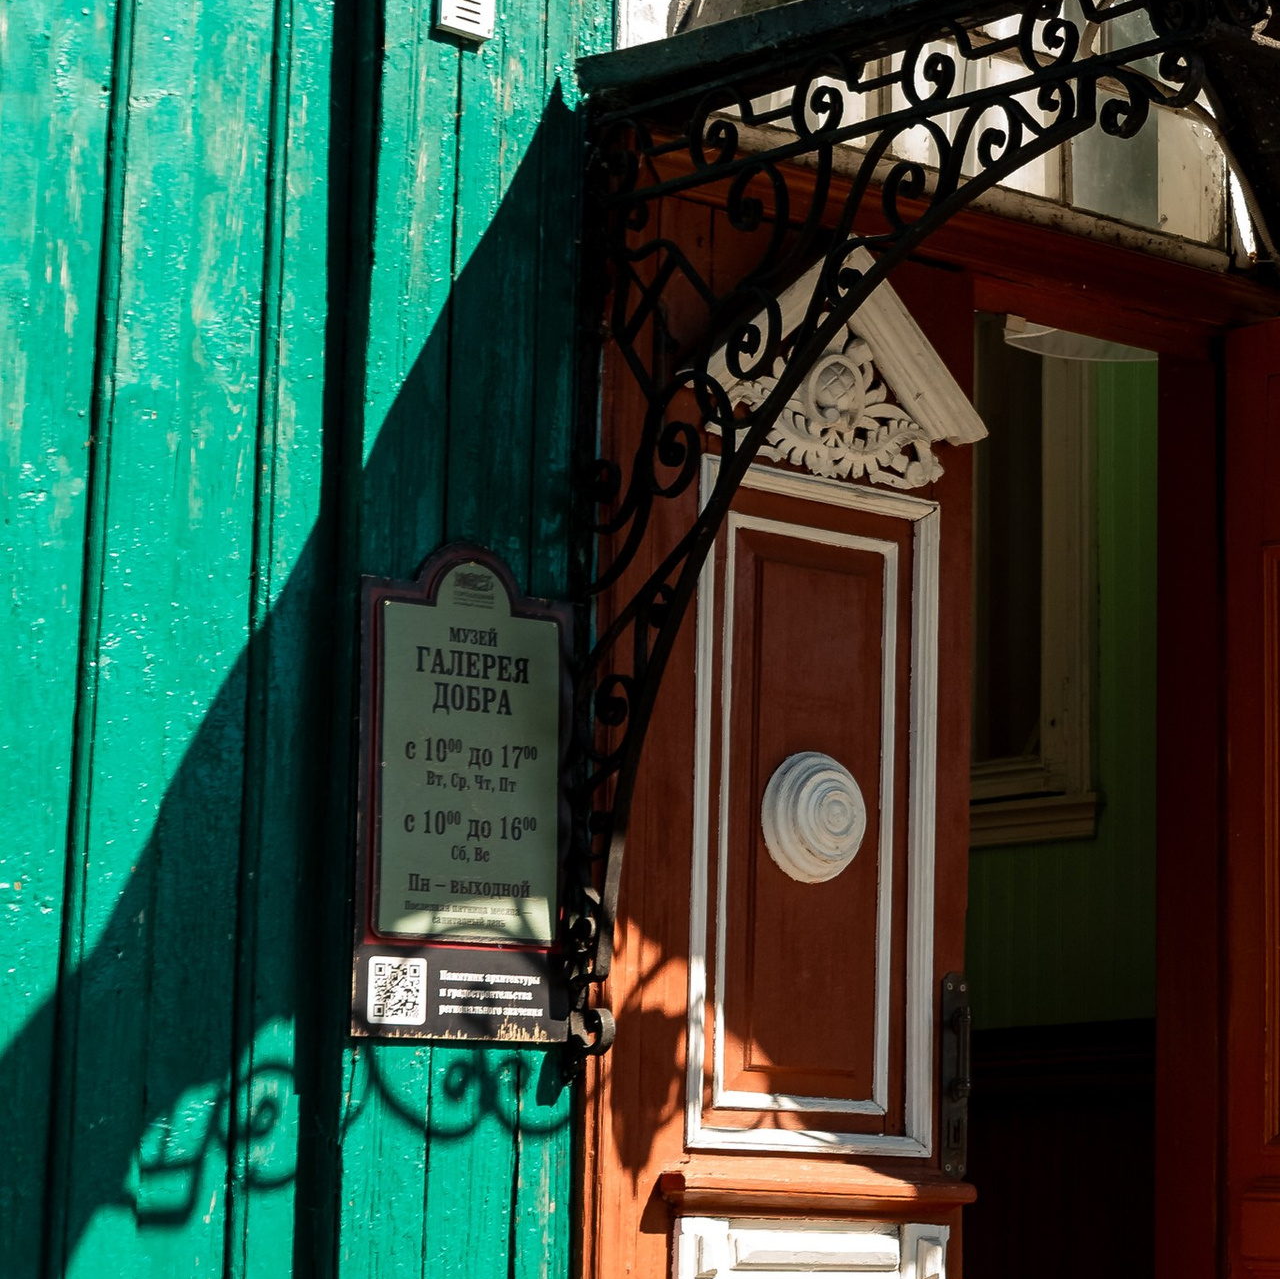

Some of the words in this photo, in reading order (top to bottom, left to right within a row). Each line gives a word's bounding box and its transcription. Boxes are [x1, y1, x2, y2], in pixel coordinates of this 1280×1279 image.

[449, 626, 498, 648] МУЗЕЙ
[416, 645, 530, 684] ГАЛЕРЕЯ
[432, 682, 513, 716] ДОБРА
[405, 740, 416, 760] с
[467, 747, 493, 770] до
[426, 770, 447, 789] Вт,
[473, 774, 495, 793] Чт,
[498, 776, 517, 793] Пт
[403, 813, 415, 833] с
[466, 818, 492, 842] до
[450, 844, 470, 863] Сб,
[473, 846, 490, 863] Вс
[408, 873, 431, 893] Пн
[450, 879, 531, 899] выходной
[485, 974, 540, 986] архитектуры
